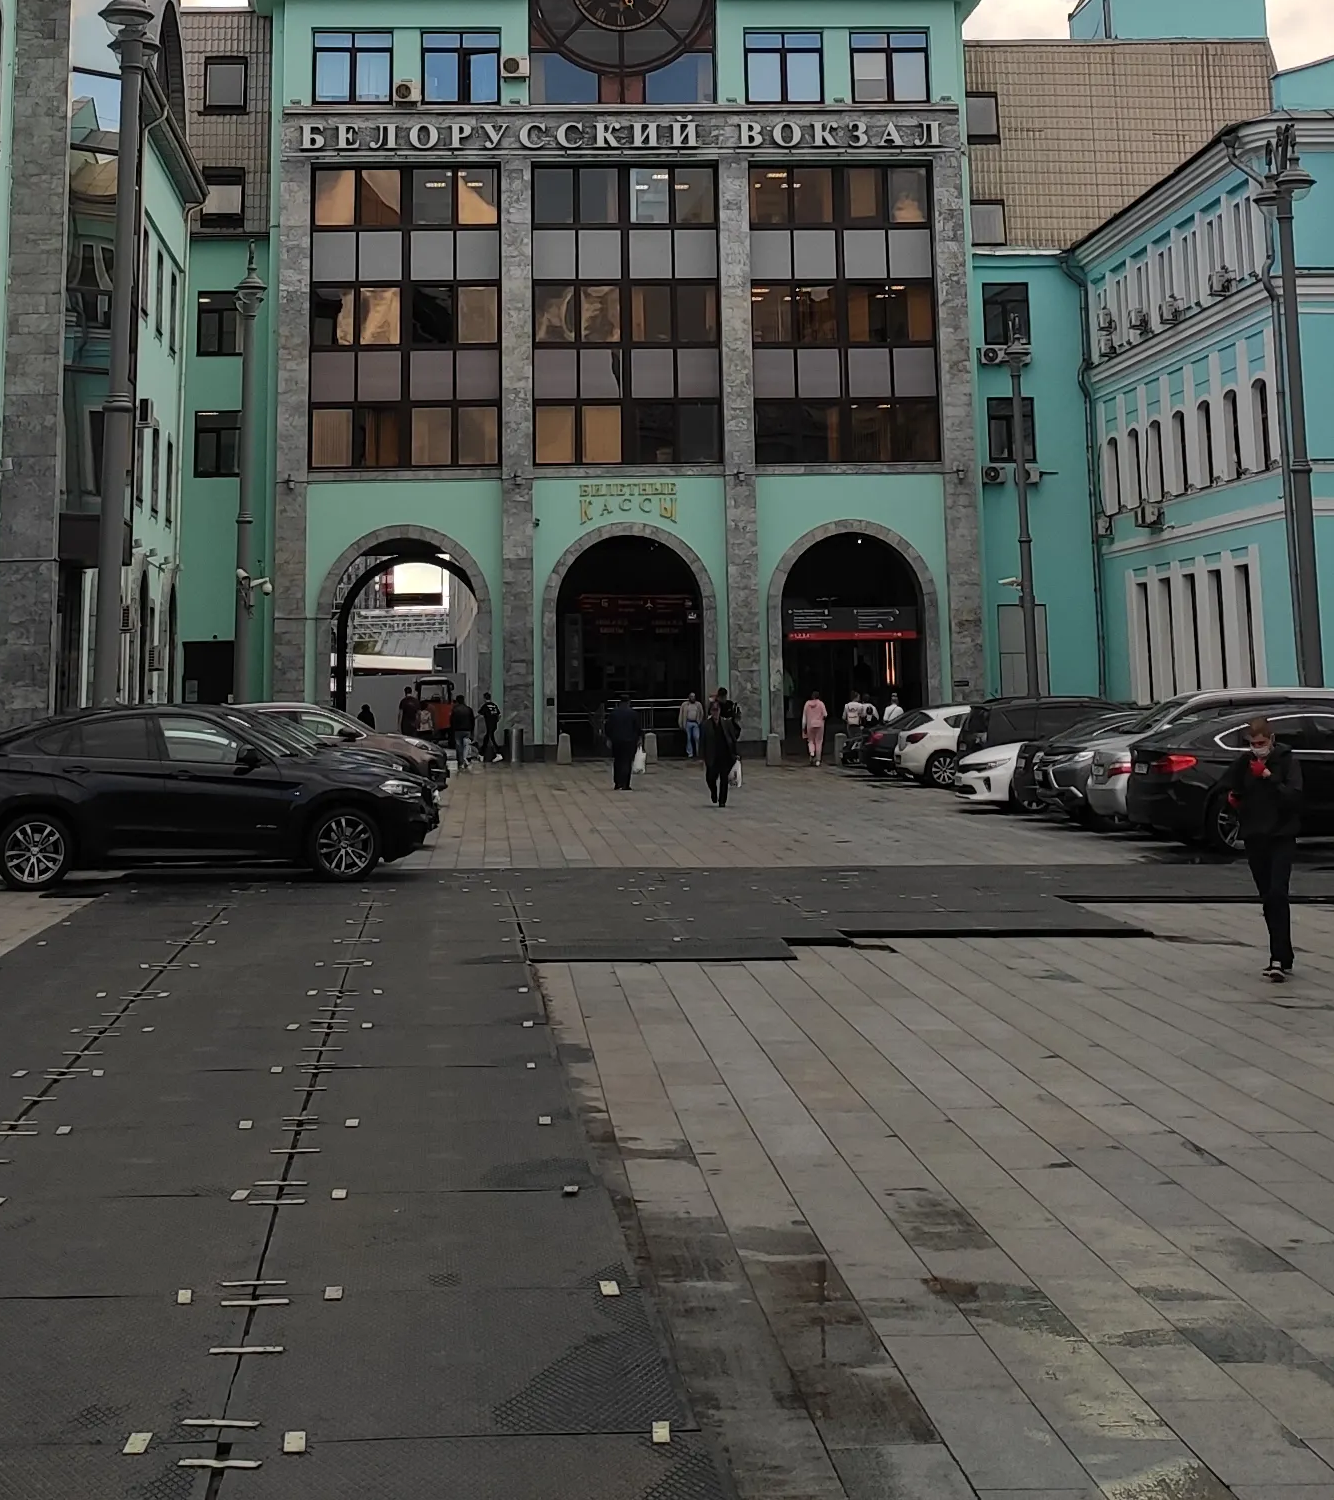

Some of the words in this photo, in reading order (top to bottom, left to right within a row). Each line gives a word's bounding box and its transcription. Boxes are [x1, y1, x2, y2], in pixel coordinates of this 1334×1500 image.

[299, 115, 701, 150] БЕЛОРУССКИЙ
[736, 120, 942, 149] ВОКЗАЛ
[579, 483, 677, 497] БИЛЕТНЫЕ
[579, 498, 677, 525] КАССЫ
